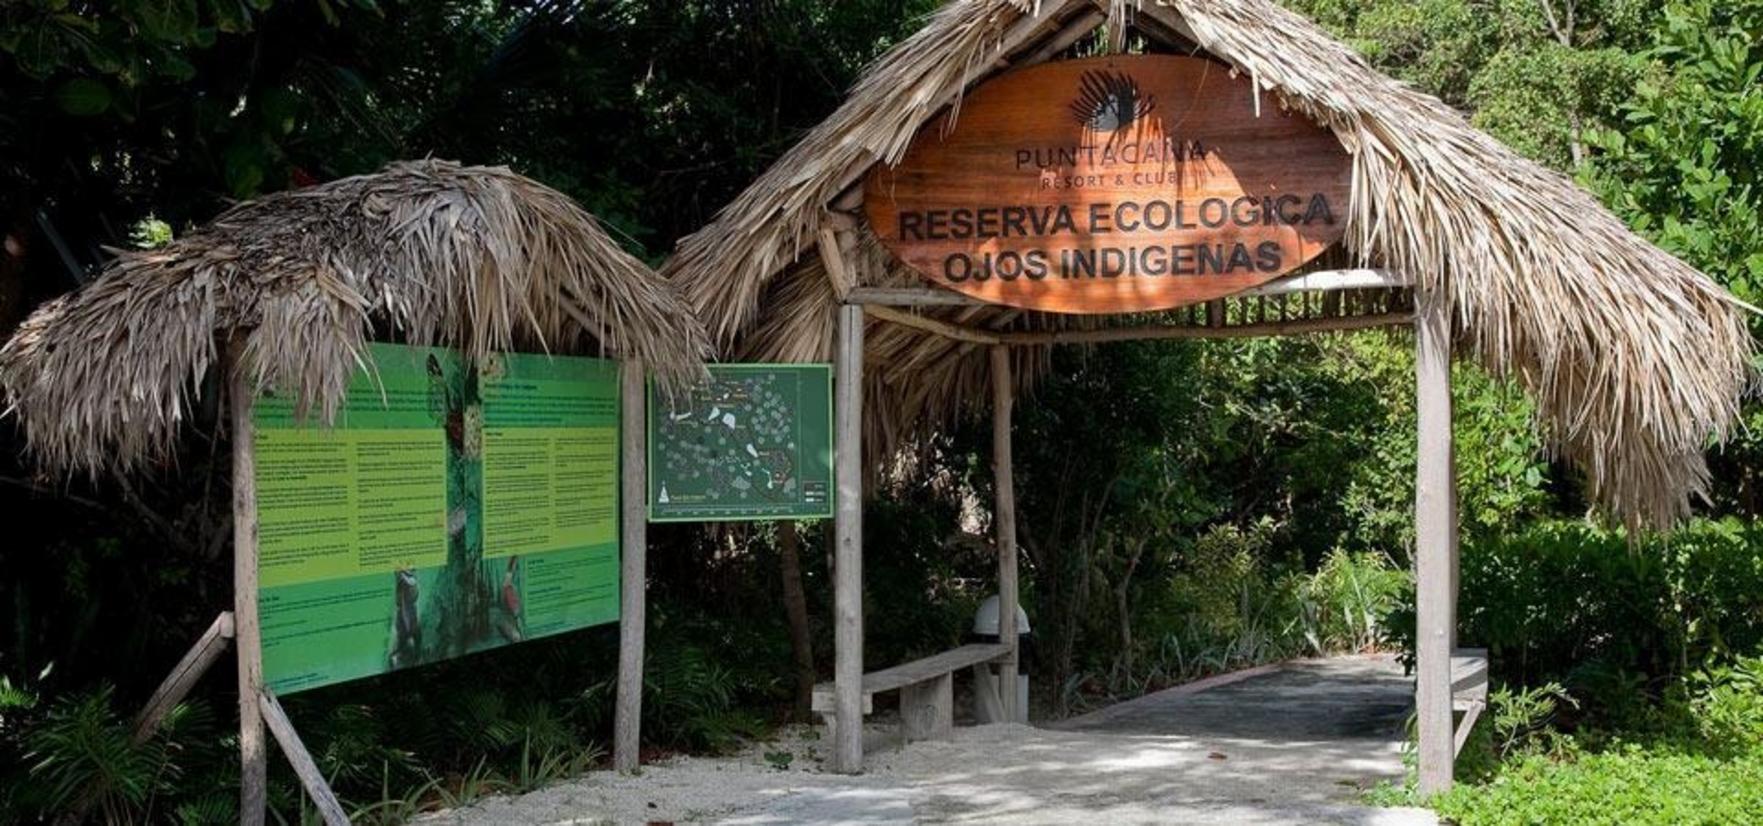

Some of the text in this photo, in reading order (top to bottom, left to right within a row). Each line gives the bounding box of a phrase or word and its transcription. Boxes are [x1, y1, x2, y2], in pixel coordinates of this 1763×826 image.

[1016, 139, 1207, 171] PUNTACANA
[1042, 171, 1178, 190] RESORT & CLUB
[900, 193, 1334, 241] RESERVA ECOLOGICA
[944, 240, 1282, 283] OJOS INDIGENAS
